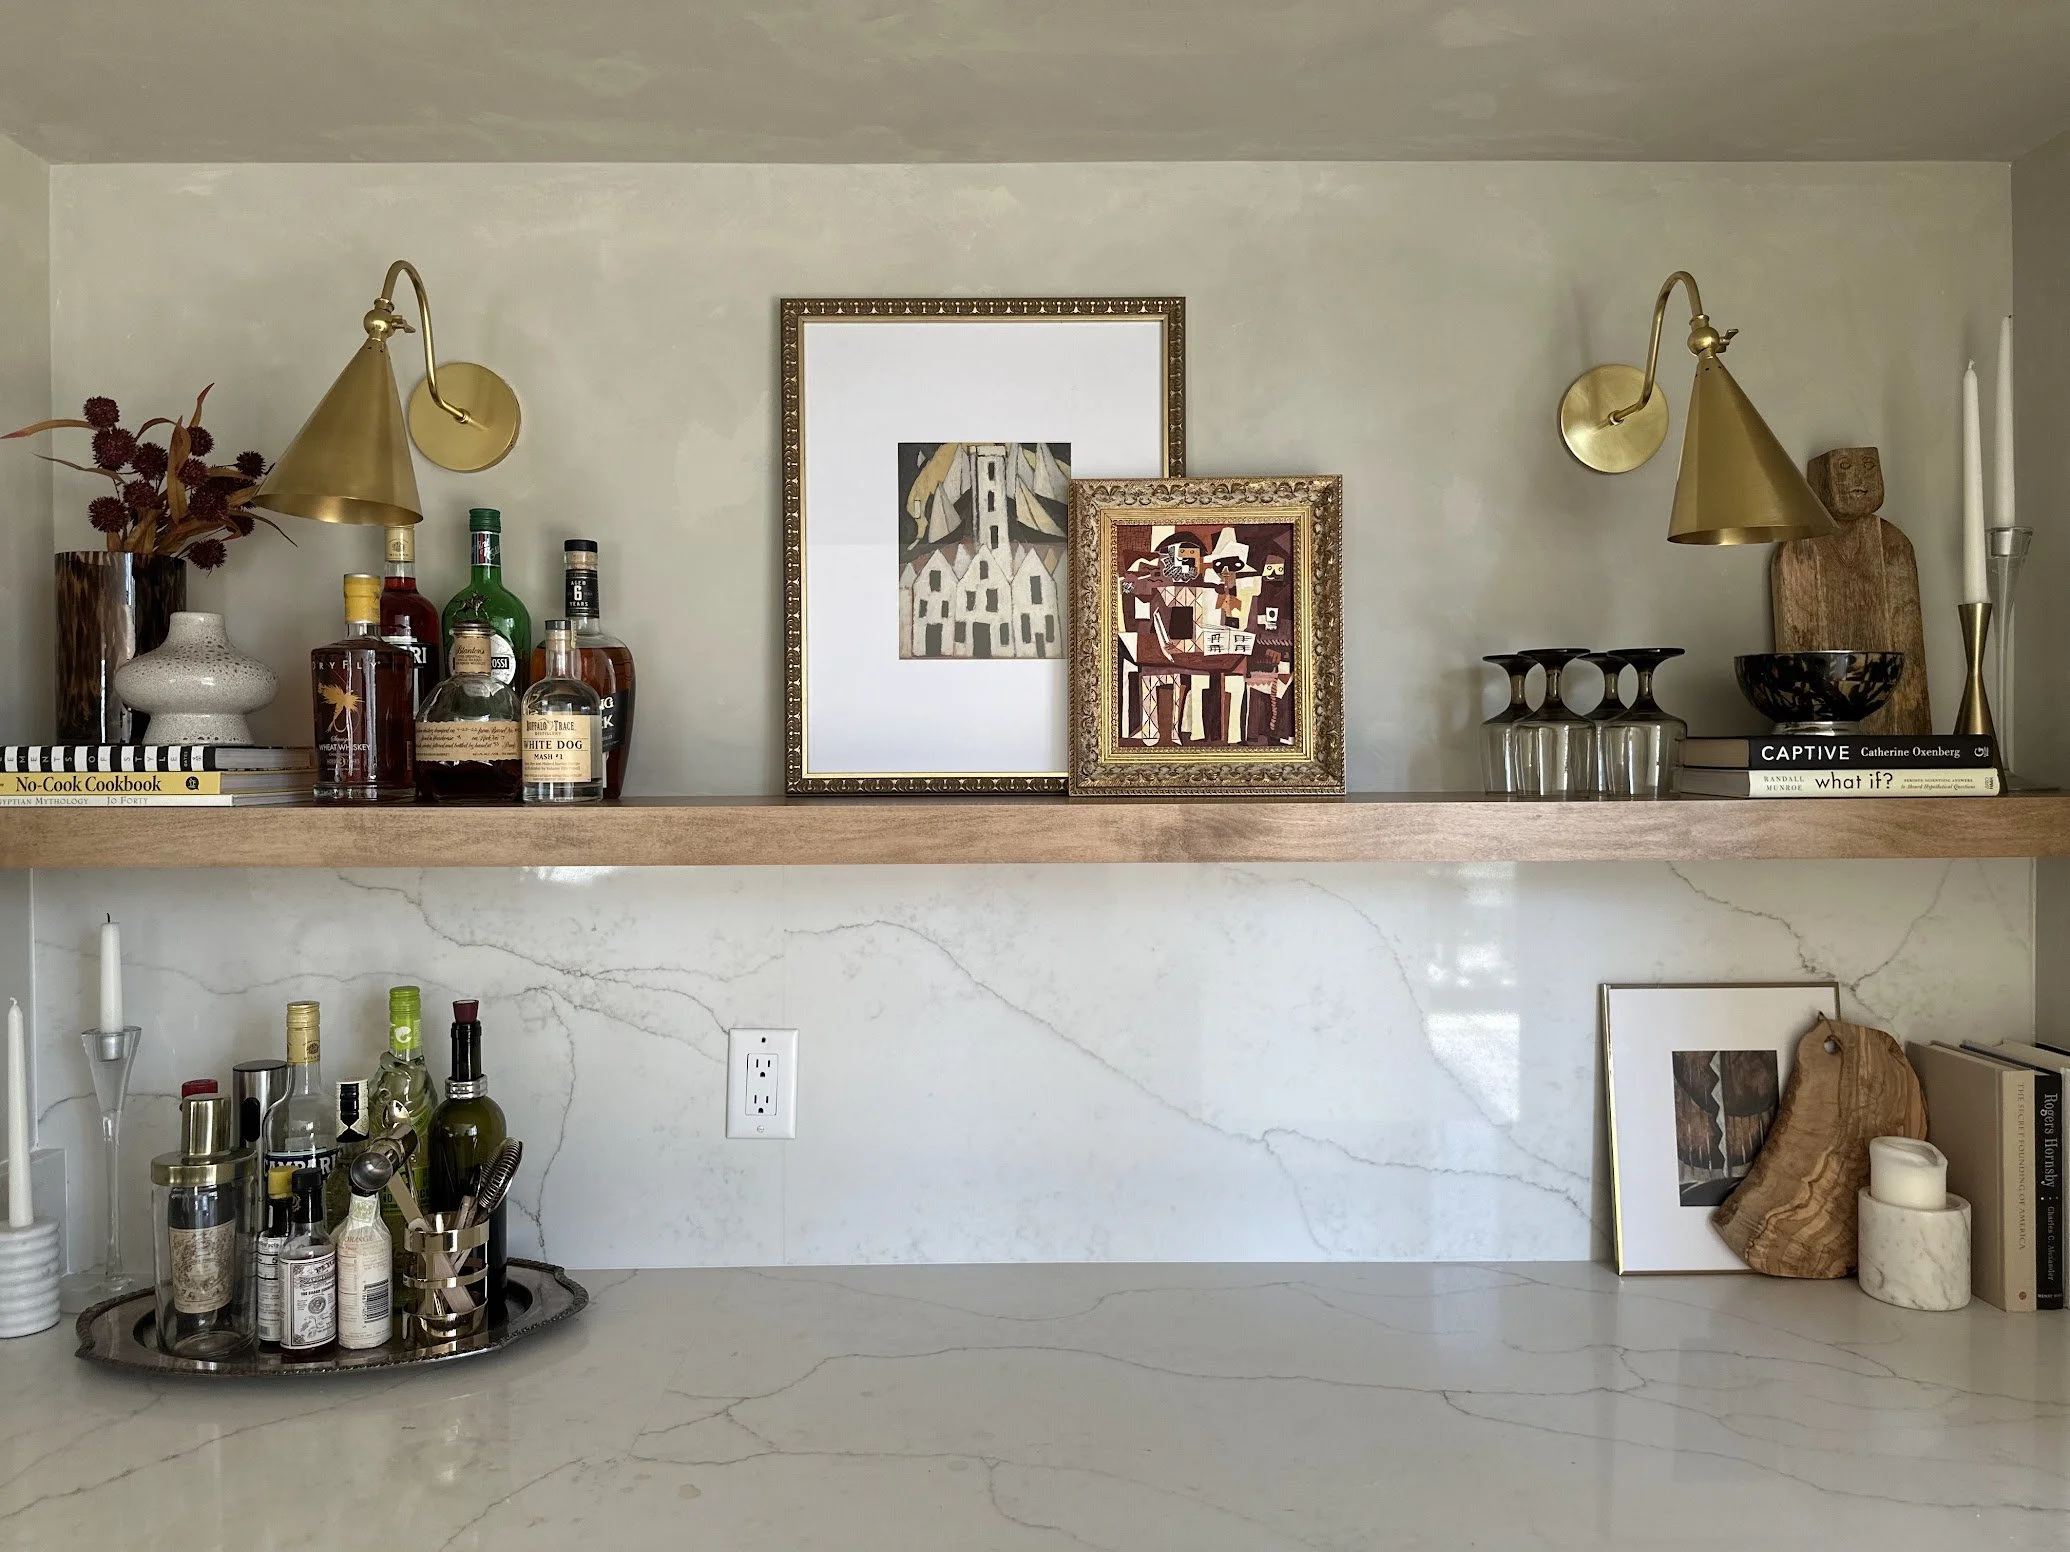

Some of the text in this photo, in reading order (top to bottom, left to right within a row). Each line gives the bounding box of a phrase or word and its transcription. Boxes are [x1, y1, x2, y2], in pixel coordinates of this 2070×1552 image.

[573, 585, 583, 601] 6
[491, 658, 509, 668] OSSI
[526, 720, 547, 732] BUFFALO
[553, 720, 575, 732] TRACE
[320, 744, 371, 752] WHEAT WHSKEY
[523, 740, 583, 750] WHITE DOG
[1761, 745, 1961, 761] CAPTIVE Catherine Oxenberg
[123, 755, 178, 763] STYLE
[16, 775, 162, 793] No-Cook Cookbook
[1766, 784, 1803, 792] MUNROE
[1815, 771, 1894, 790] what if?
[35, 797, 89, 806] MYTHOLOGY
[120, 796, 149, 805] FORTY
[2017, 1083, 2025, 1102] THE
[2040, 1093, 2059, 1188] Rogers Hornsby
[2018, 1139, 2026, 1192] FOUNDING
[2018, 1193, 2026, 1206] OF
[2047, 1206, 2055, 1233] Charles
[2018, 1206, 2026, 1250] AMERICA
[2047, 1245, 2055, 1281] Alexander
